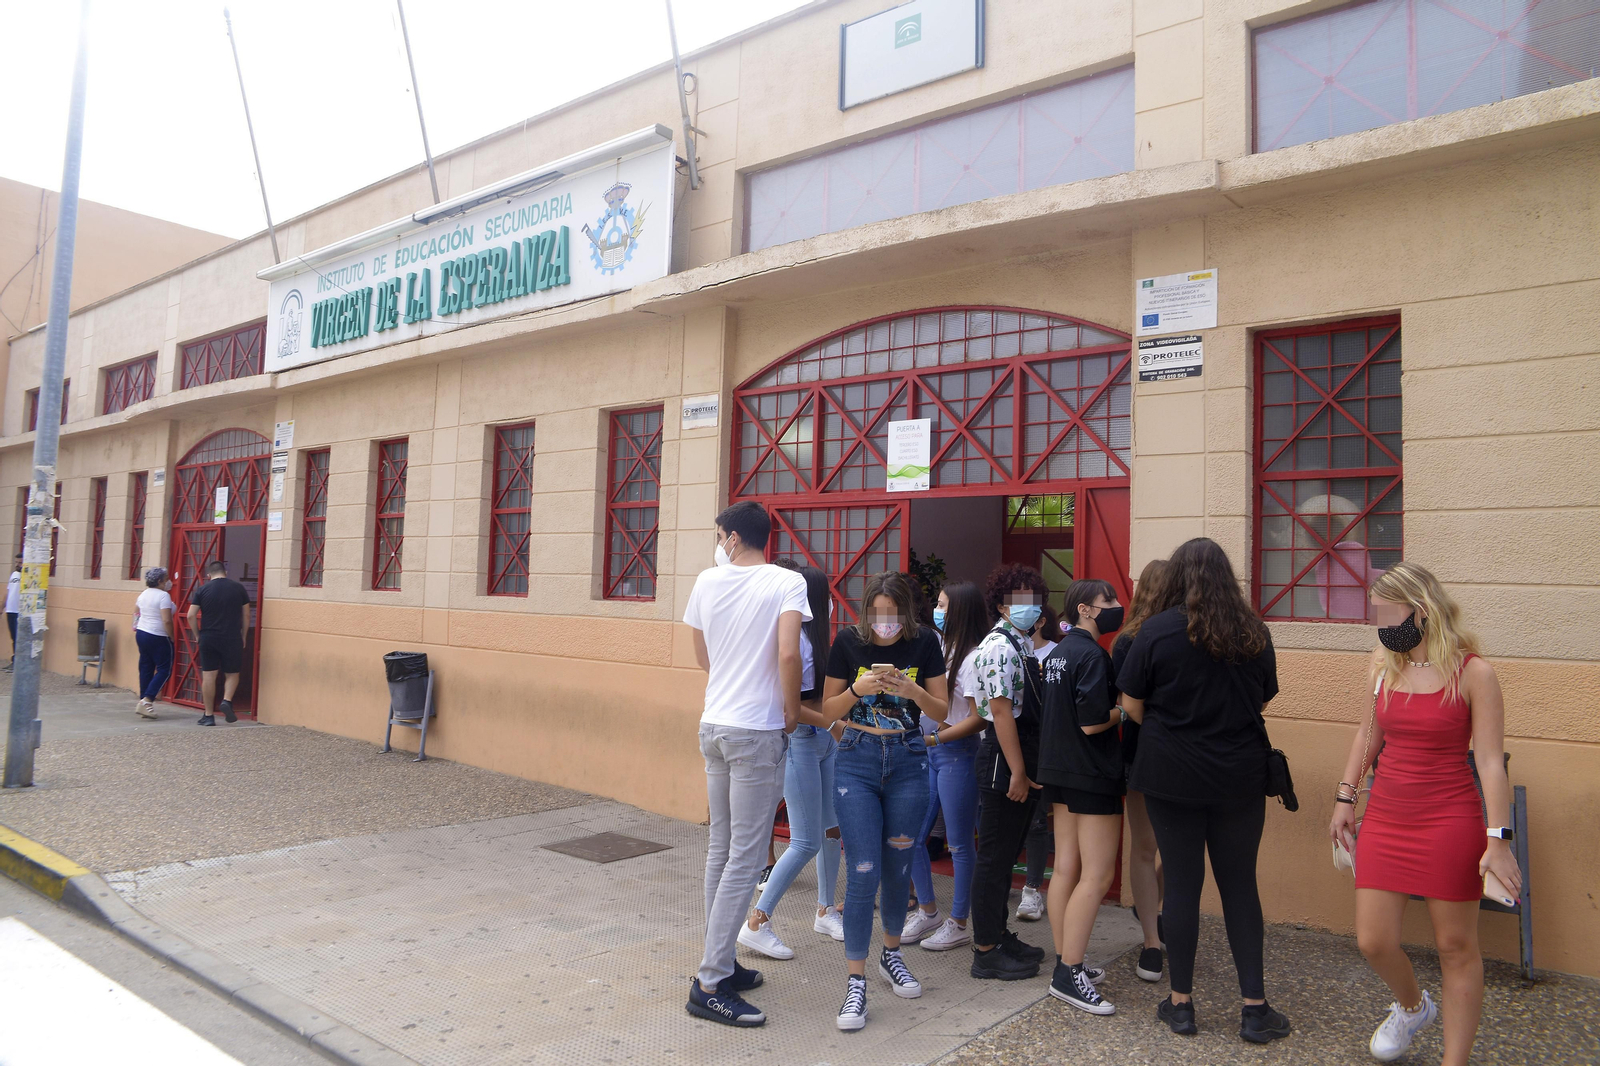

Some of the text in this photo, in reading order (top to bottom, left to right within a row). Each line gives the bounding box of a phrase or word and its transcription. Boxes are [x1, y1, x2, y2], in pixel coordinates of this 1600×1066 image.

[317, 192, 572, 293] INSTITUTO DE EDUCACIÓN SECUNDARIA
[311, 225, 571, 348] VIRGEN DE LA ESPERANZA
[1156, 336, 1197, 345] VIDEOVIGILADA
[1153, 349, 1200, 360] PROTELEC
[706, 997, 733, 1019] Calvin
